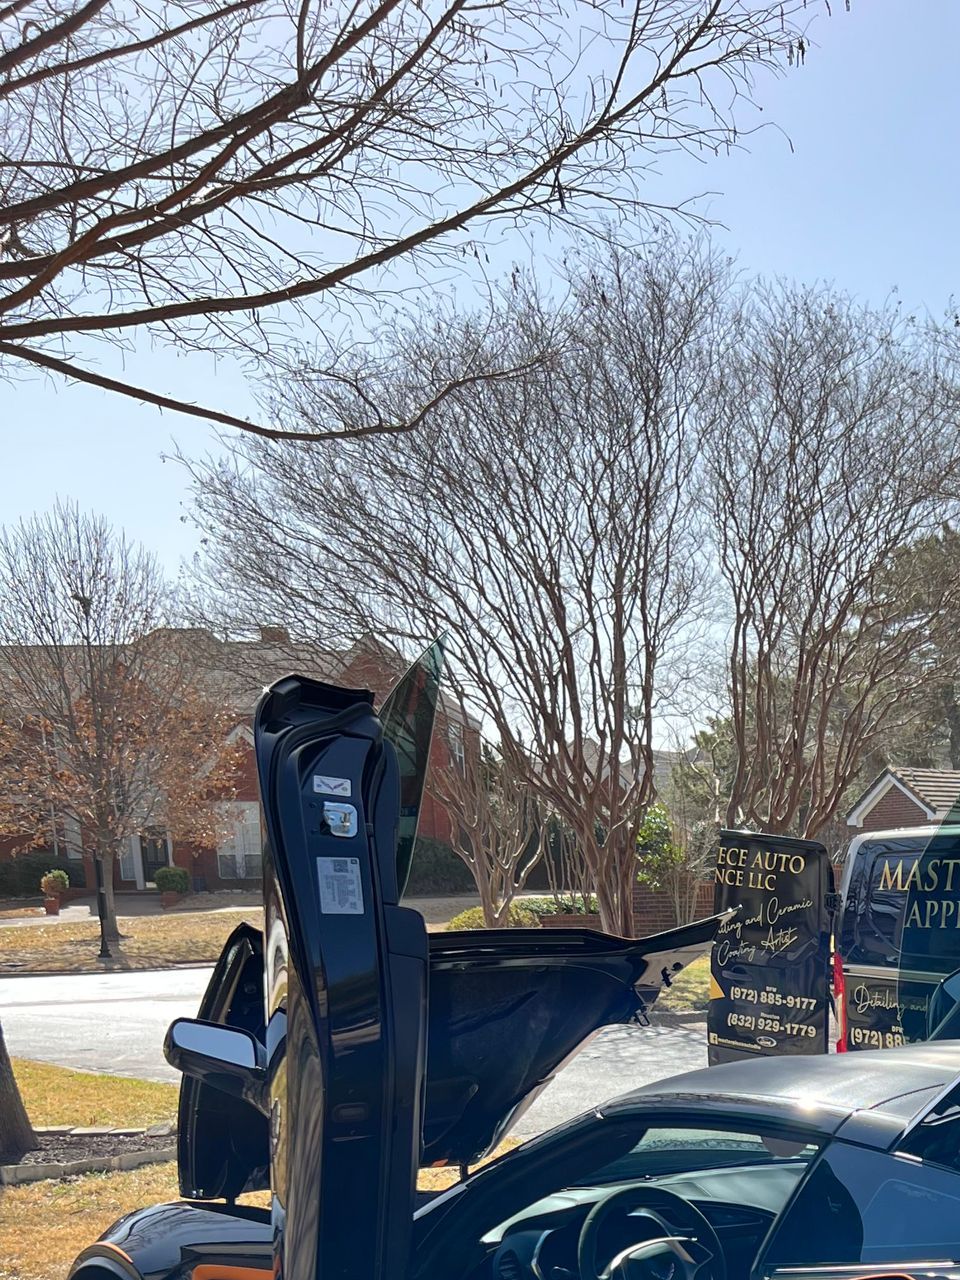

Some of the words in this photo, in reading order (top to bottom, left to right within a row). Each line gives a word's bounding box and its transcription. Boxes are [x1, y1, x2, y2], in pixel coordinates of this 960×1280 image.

[717, 846, 748, 867] ECE
[751, 851, 805, 874] AUTO
[714, 868, 744, 886] NCE
[748, 872, 776, 891] LLC
[745, 903, 763, 927] and
[767, 897, 813, 924] Ceramic
[717, 940, 756, 966] Coating
[761, 926, 797, 956] Artist
[730, 986, 758, 1004] (972)
[760, 991, 817, 1011] 885-9177
[854, 982, 905, 1021] Detailing
[727, 1012, 756, 1031] (832)
[758, 1018, 817, 1038] 929-1779
[850, 1027, 882, 1049] (972)
